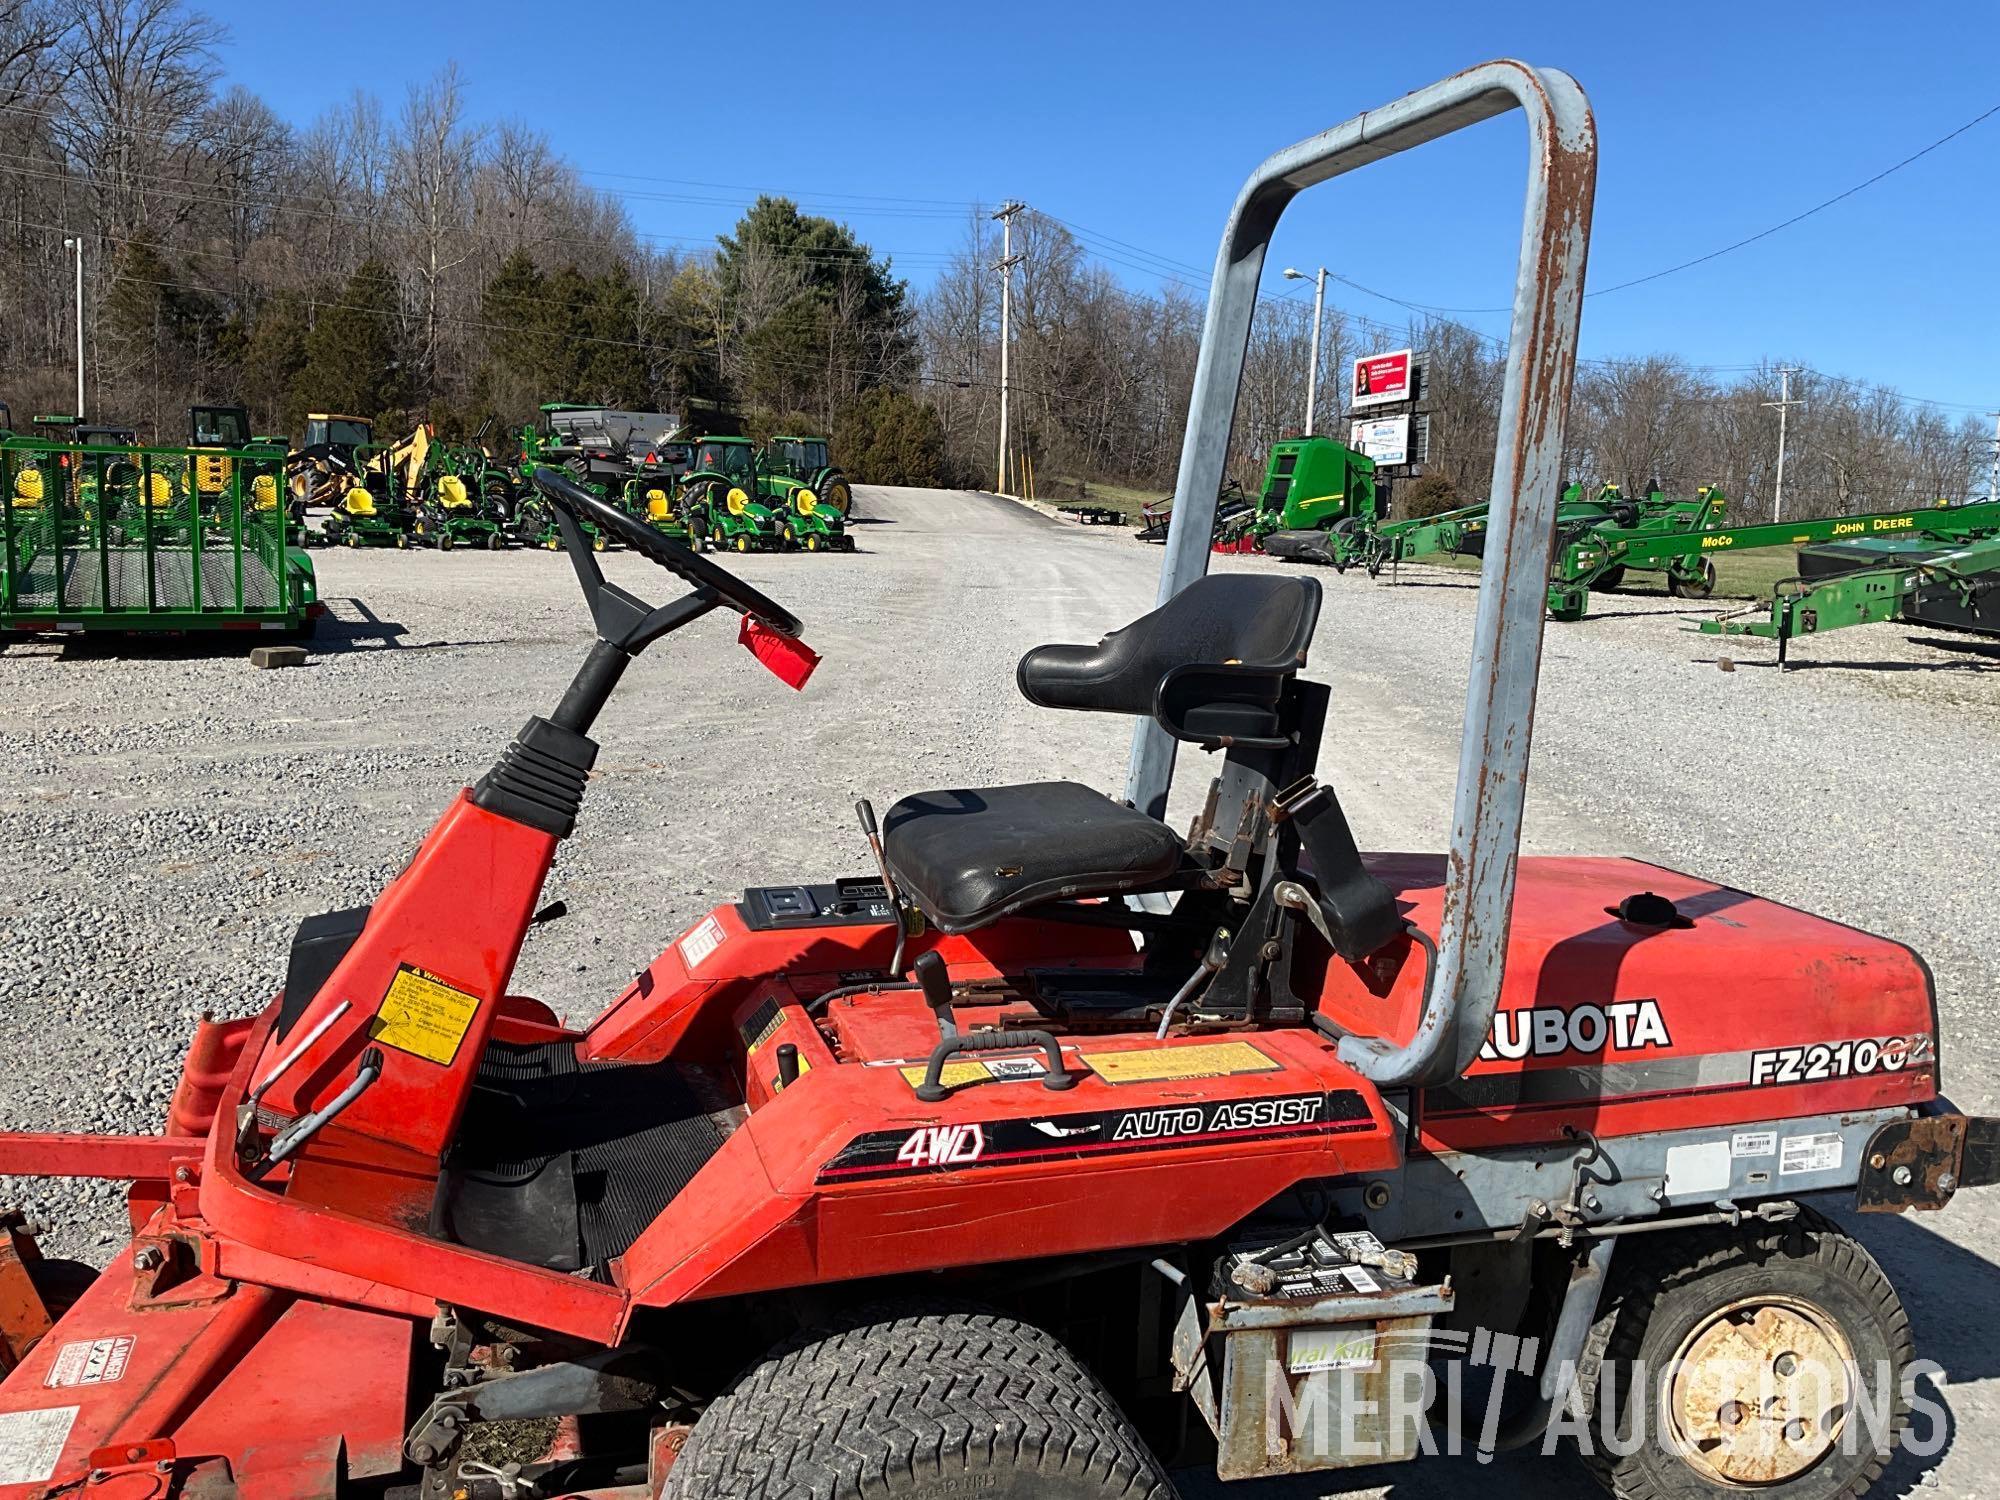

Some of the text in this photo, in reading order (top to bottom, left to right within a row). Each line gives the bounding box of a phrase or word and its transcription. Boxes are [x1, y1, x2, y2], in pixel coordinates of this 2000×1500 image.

[1702, 536, 1733, 547] MoCo
[1832, 517, 1914, 535] JOHN DEERE
[1480, 1001, 1670, 1059] UBOTA
[1113, 1097, 1323, 1140] AUTO ASSIST
[897, 1124, 986, 1166] 4WD
